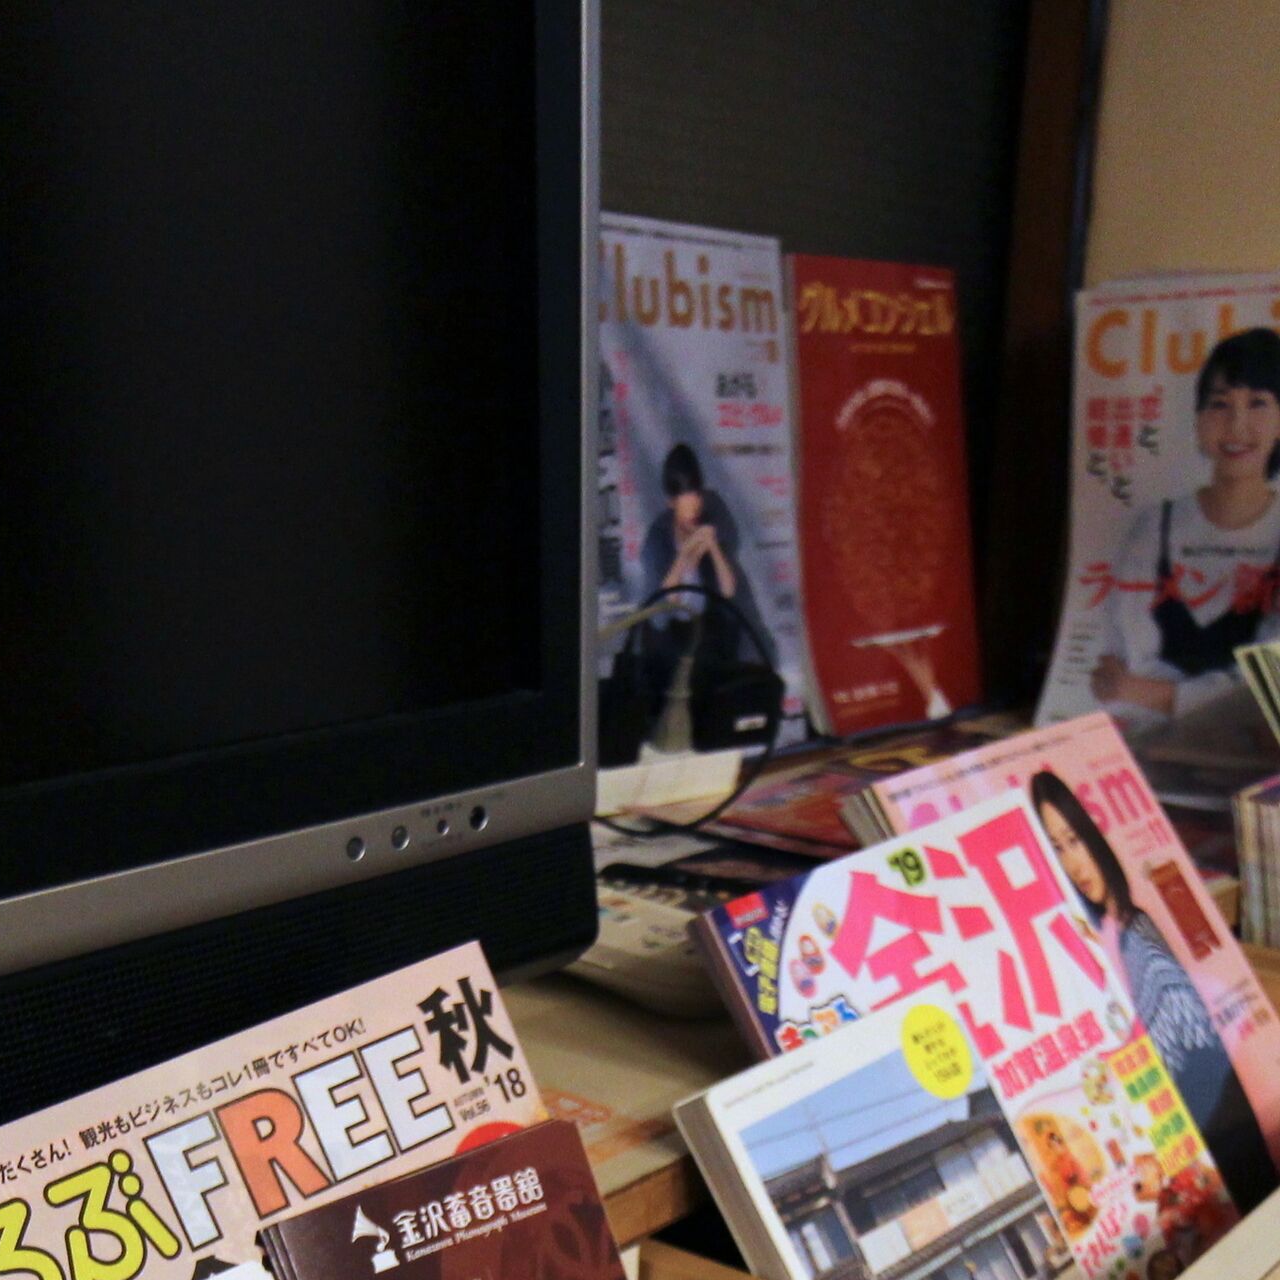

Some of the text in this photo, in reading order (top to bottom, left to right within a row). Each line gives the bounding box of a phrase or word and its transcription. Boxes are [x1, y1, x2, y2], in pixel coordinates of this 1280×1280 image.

[598, 239, 779, 333] lubism
[416, 976, 515, 1085] 秋
[392, 1165, 545, 1250] 金沢蓄音器館
